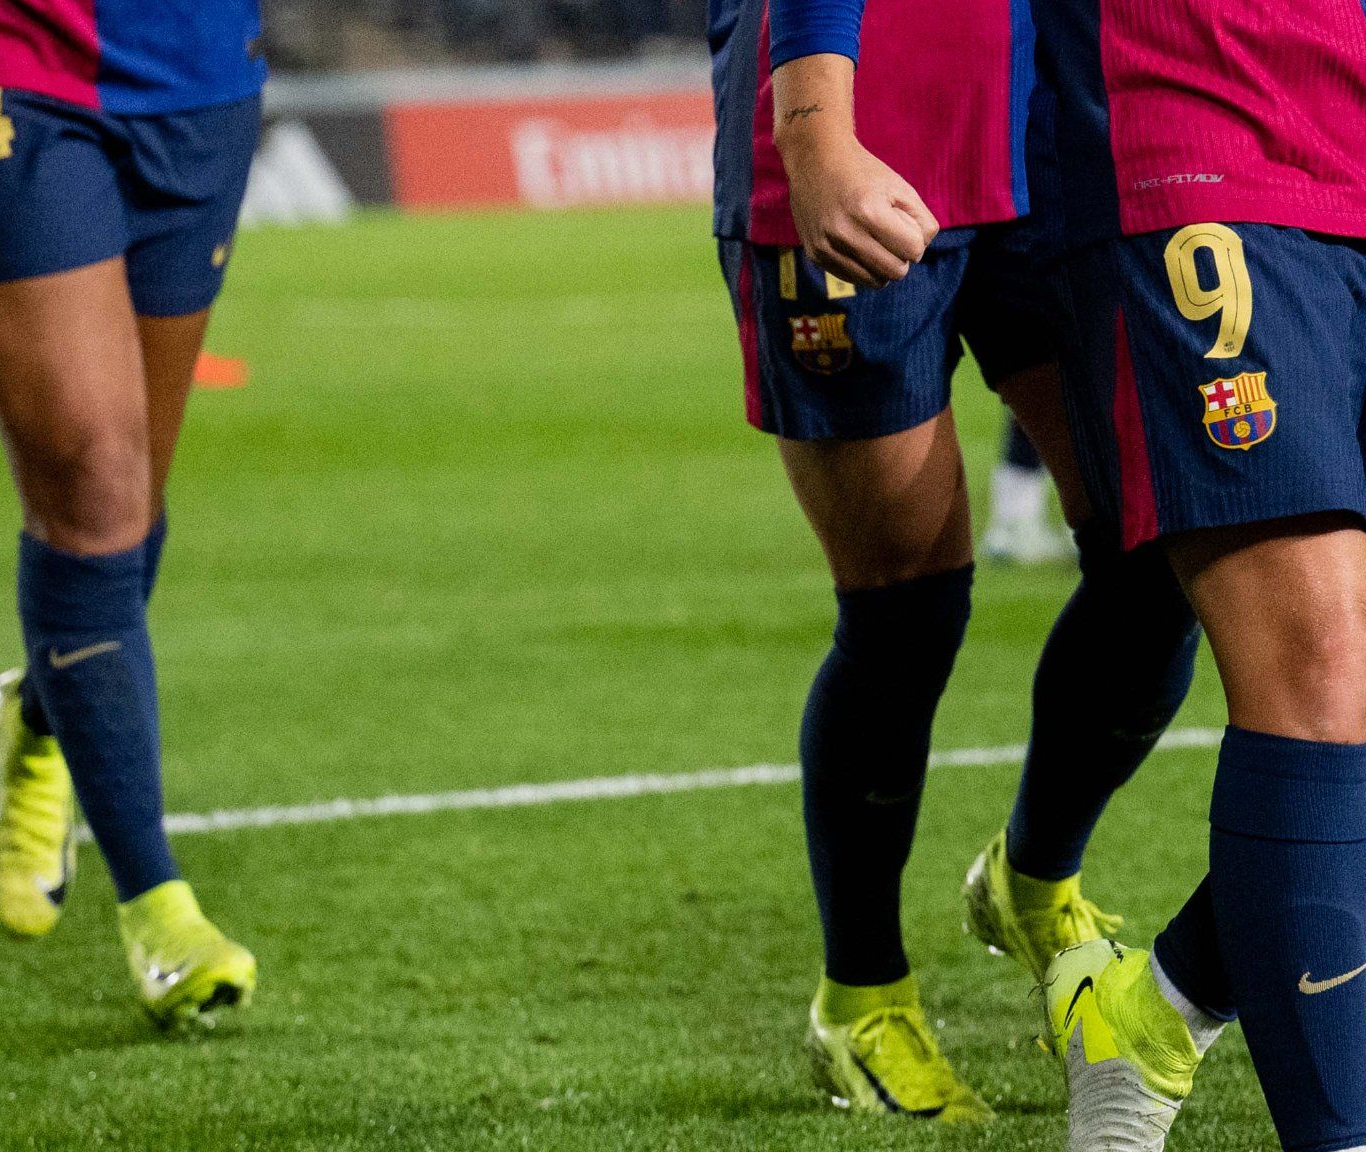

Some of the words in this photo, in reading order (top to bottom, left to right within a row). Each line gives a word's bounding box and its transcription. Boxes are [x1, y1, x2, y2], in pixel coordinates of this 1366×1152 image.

[511, 111, 714, 207] Emira
[1164, 222, 1254, 358] 9
[1223, 404, 1253, 418] FCB
